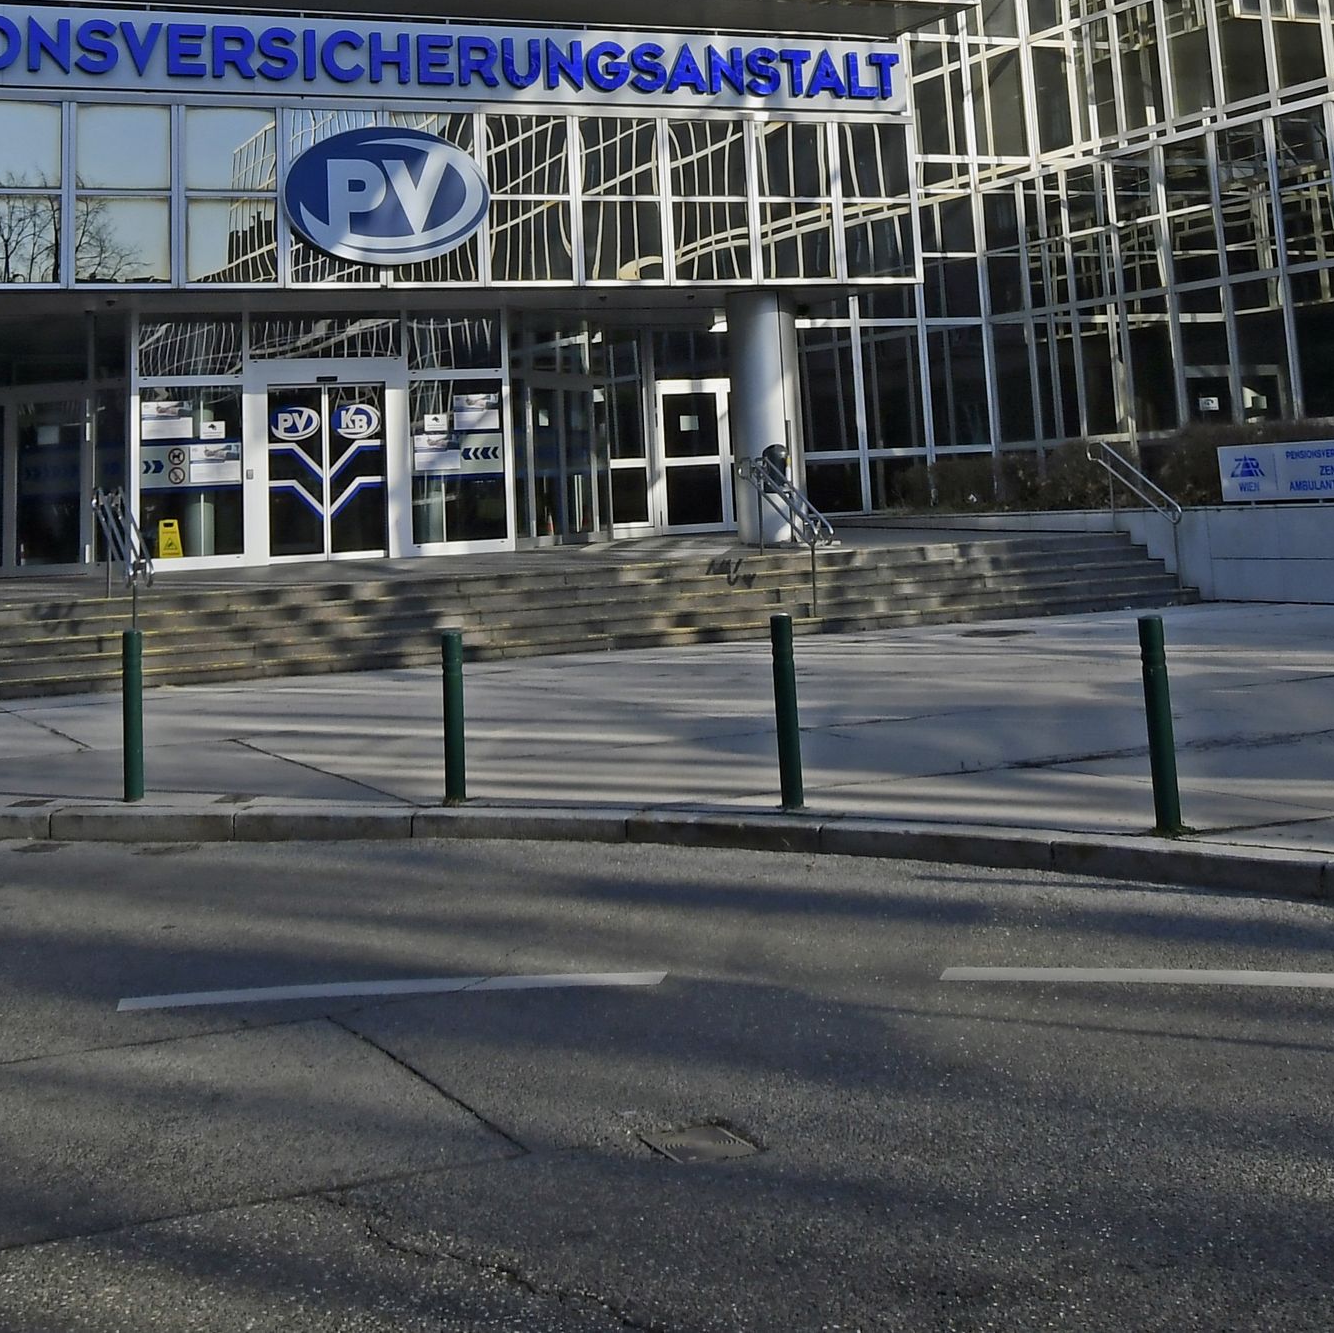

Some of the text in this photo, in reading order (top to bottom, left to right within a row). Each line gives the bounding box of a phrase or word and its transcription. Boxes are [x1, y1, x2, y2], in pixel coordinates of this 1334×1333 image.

[325, 150, 451, 236] PV
[277, 410, 309, 434] PV
[341, 406, 368, 431] KB
[1238, 481, 1260, 493] WIEN
